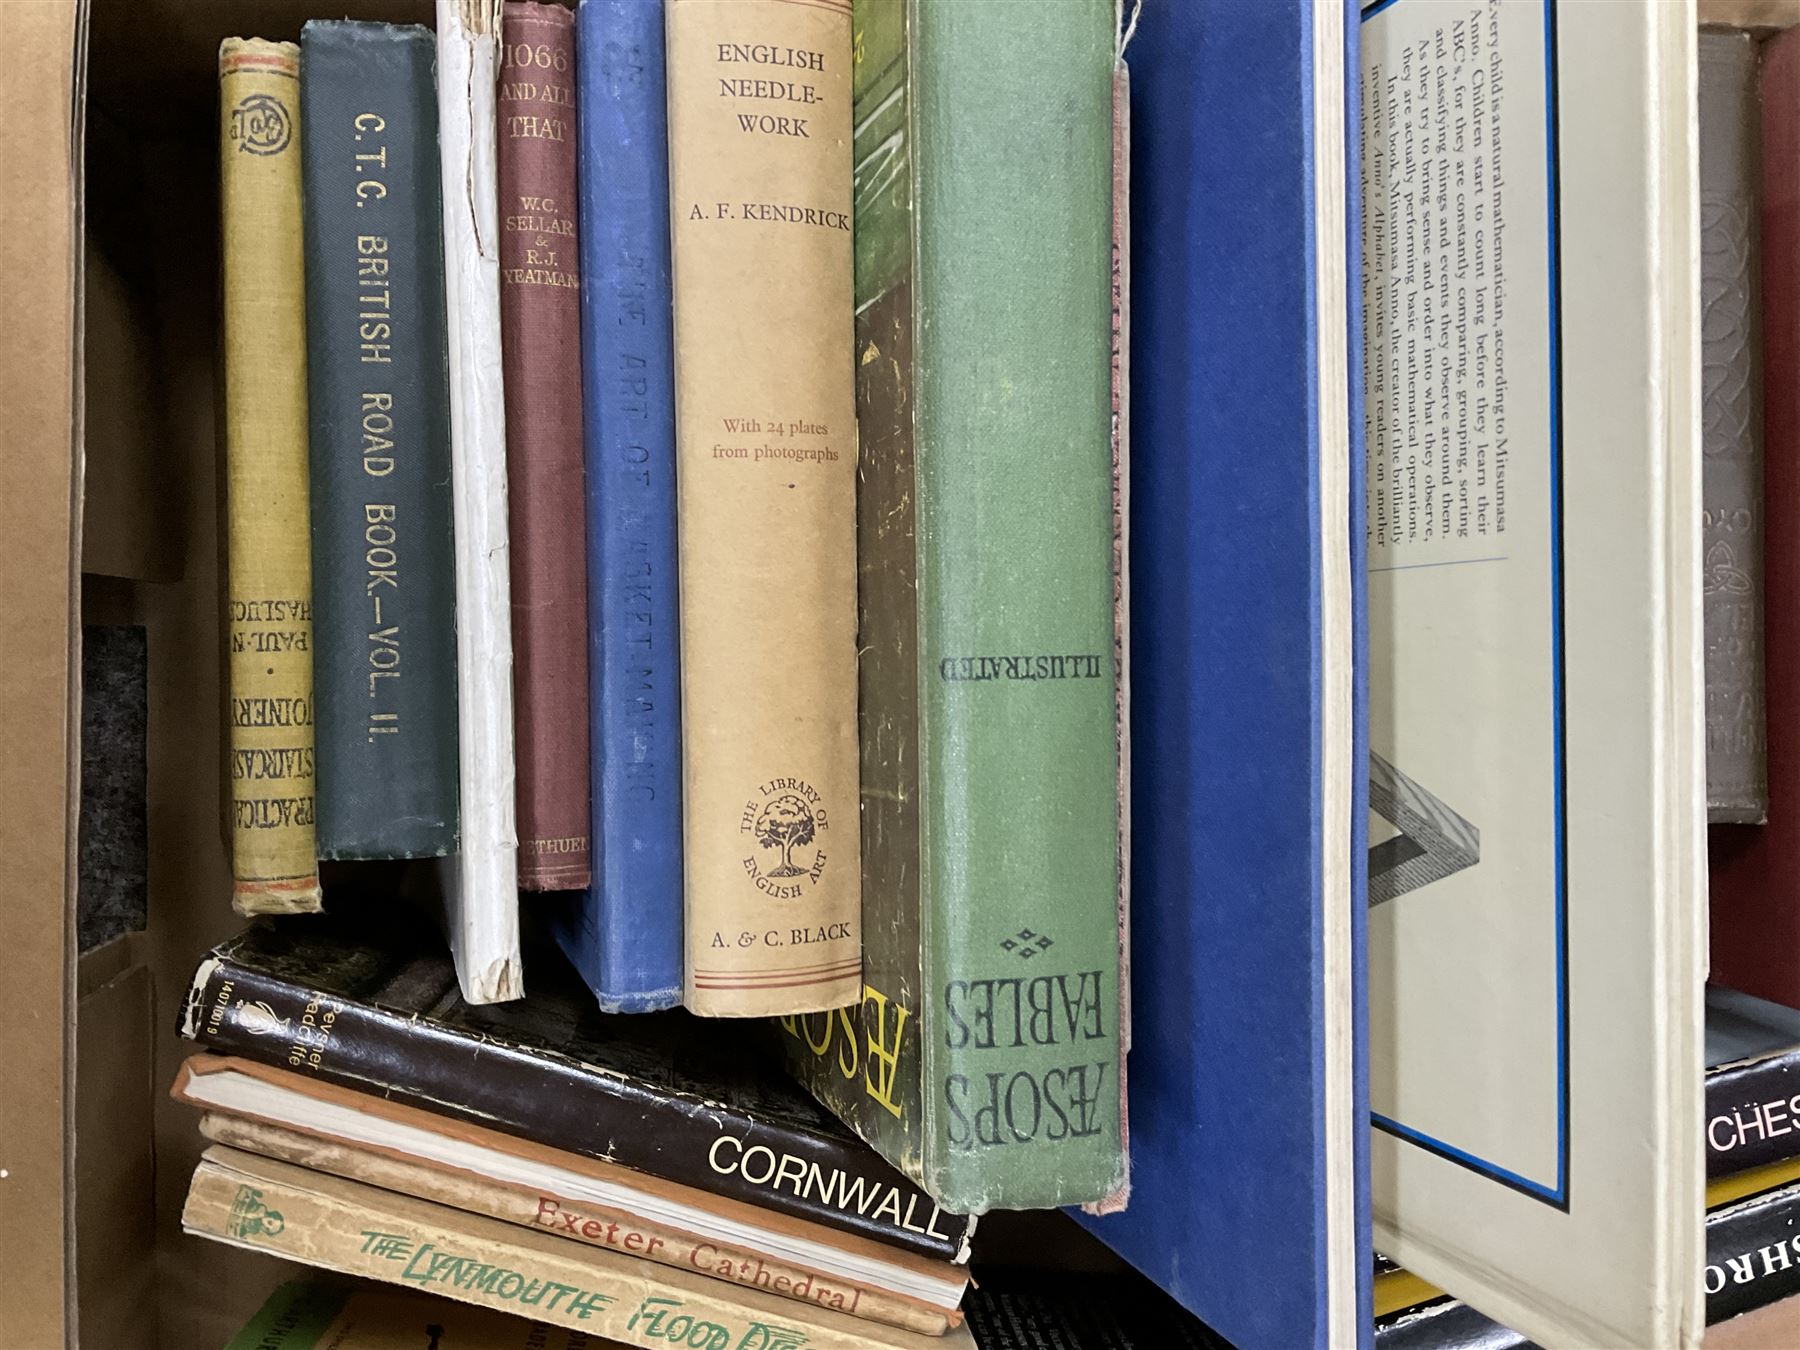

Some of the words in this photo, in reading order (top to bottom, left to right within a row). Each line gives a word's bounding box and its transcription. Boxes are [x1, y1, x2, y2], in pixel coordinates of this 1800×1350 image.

[1418, 40, 1430, 60] As
[1435, 29, 1447, 60] and
[1470, 9, 1482, 62] Anno.
[504, 44, 568, 71] 1066
[717, 44, 825, 71] ENGLISH
[1401, 47, 1413, 82] they
[1490, 52, 1504, 95] child
[501, 82, 538, 102] AND
[541, 84, 573, 106] ALL
[719, 79, 824, 104] NEEDLE-
[1371, 64, 1383, 139] inventive
[1387, 75, 1398, 94] In
[1404, 89, 1412, 116] are
[1418, 65, 1430, 100] they
[1454, 85, 1466, 109] for
[737, 114, 809, 138] WORK
[1388, 98, 1399, 128] this
[1419, 108, 1429, 130] try
[1435, 65, 1449, 154] classifying
[1472, 69, 1485, 147] Children
[1491, 99, 1504, 112] is
[1491, 115, 1500, 124] a
[507, 116, 566, 142] THAT
[1421, 137, 1430, 155] to
[1454, 117, 1467, 153] they
[1388, 131, 1400, 178] book,
[1403, 121, 1416, 183] actually
[1491, 127, 1505, 188] natural
[1420, 159, 1432, 205] bring
[1437, 158, 1450, 212] things
[1456, 161, 1465, 188] are
[1473, 156, 1485, 195] start
[506, 216, 574, 237] SELLAR
[689, 203, 709, 220] A.
[716, 203, 735, 220] F.
[742, 204, 851, 231] KENDRICK
[1389, 182, 1401, 270] Mitsumasa
[1423, 211, 1431, 255] sense
[1439, 218, 1451, 249] and
[1474, 204, 1484, 221] to
[535, 235, 549, 247] &
[1373, 206, 1385, 280] Alphabet,
[1404, 192, 1418, 285] performing
[1454, 193, 1468, 279] constantly
[1475, 230, 1486, 279] count
[504, 269, 577, 288] YEATMAN
[1424, 261, 1434, 290] and
[1492, 192, 1507, 327] mathematician,
[357, 235, 391, 364] BRITISH
[1390, 275, 1401, 325] Anno,
[1440, 255, 1450, 308] events
[1376, 285, 1386, 338] invites
[1408, 291, 1418, 332] basic
[1424, 297, 1434, 341] order
[1473, 286, 1488, 326] long
[1392, 328, 1402, 354] the
[1438, 314, 1452, 350] they
[1455, 287, 1470, 385] comparing,
[1374, 345, 1385, 393] young
[1424, 348, 1435, 381] into
[1476, 333, 1488, 389] before
[1492, 330, 1508, 414] according
[1392, 359, 1402, 414] creator
[1408, 339, 1419, 448] mathematical
[1424, 387, 1436, 425] what
[1441, 357, 1452, 420] observe
[361, 392, 395, 477] ROAD
[722, 418, 762, 434] With
[767, 422, 785, 436] 24
[789, 420, 828, 437] plates
[1377, 400, 1387, 456] readers
[1392, 418, 1403, 435] of
[1456, 390, 1470, 474] grouping,
[1474, 397, 1488, 434] they
[1495, 418, 1505, 434] to
[712, 444, 749, 459] from
[754, 444, 839, 463] photographs
[1392, 439, 1403, 464] the
[1422, 433, 1436, 468] they
[1442, 427, 1453, 485] around
[1477, 444, 1489, 486] learn
[1377, 463, 1385, 482] on
[1495, 439, 1508, 533] Mitsumasa
[1377, 489, 1387, 547] another
[1390, 469, 1403, 545] brilliantly
[1406, 455, 1420, 543] operations.
[1424, 475, 1436, 542] observe,
[1442, 492, 1453, 539] them.
[1457, 480, 1471, 538] sorting
[1478, 496, 1490, 535] their
[940, 654, 1102, 680] ILLUSTRATED
[740, 800, 758, 833] THE
[759, 778, 821, 804] LIBRARY
[816, 809, 828, 831] OF
[743, 856, 802, 899] ENGLISH
[809, 850, 828, 885] ART
[711, 932, 730, 948] A.
[738, 931, 756, 948] &
[764, 930, 783, 947] C.
[791, 922, 851, 945] BLACK
[944, 971, 1107, 1050] FABLES
[709, 1136, 950, 1241] CORNWALL
[535, 1196, 665, 1257] Exeter
[690, 1244, 864, 1314] Cathedral
[359, 1230, 416, 1259] THE
[402, 1244, 618, 1320] LYNMOUTH
[627, 1297, 730, 1350] FLOOD
